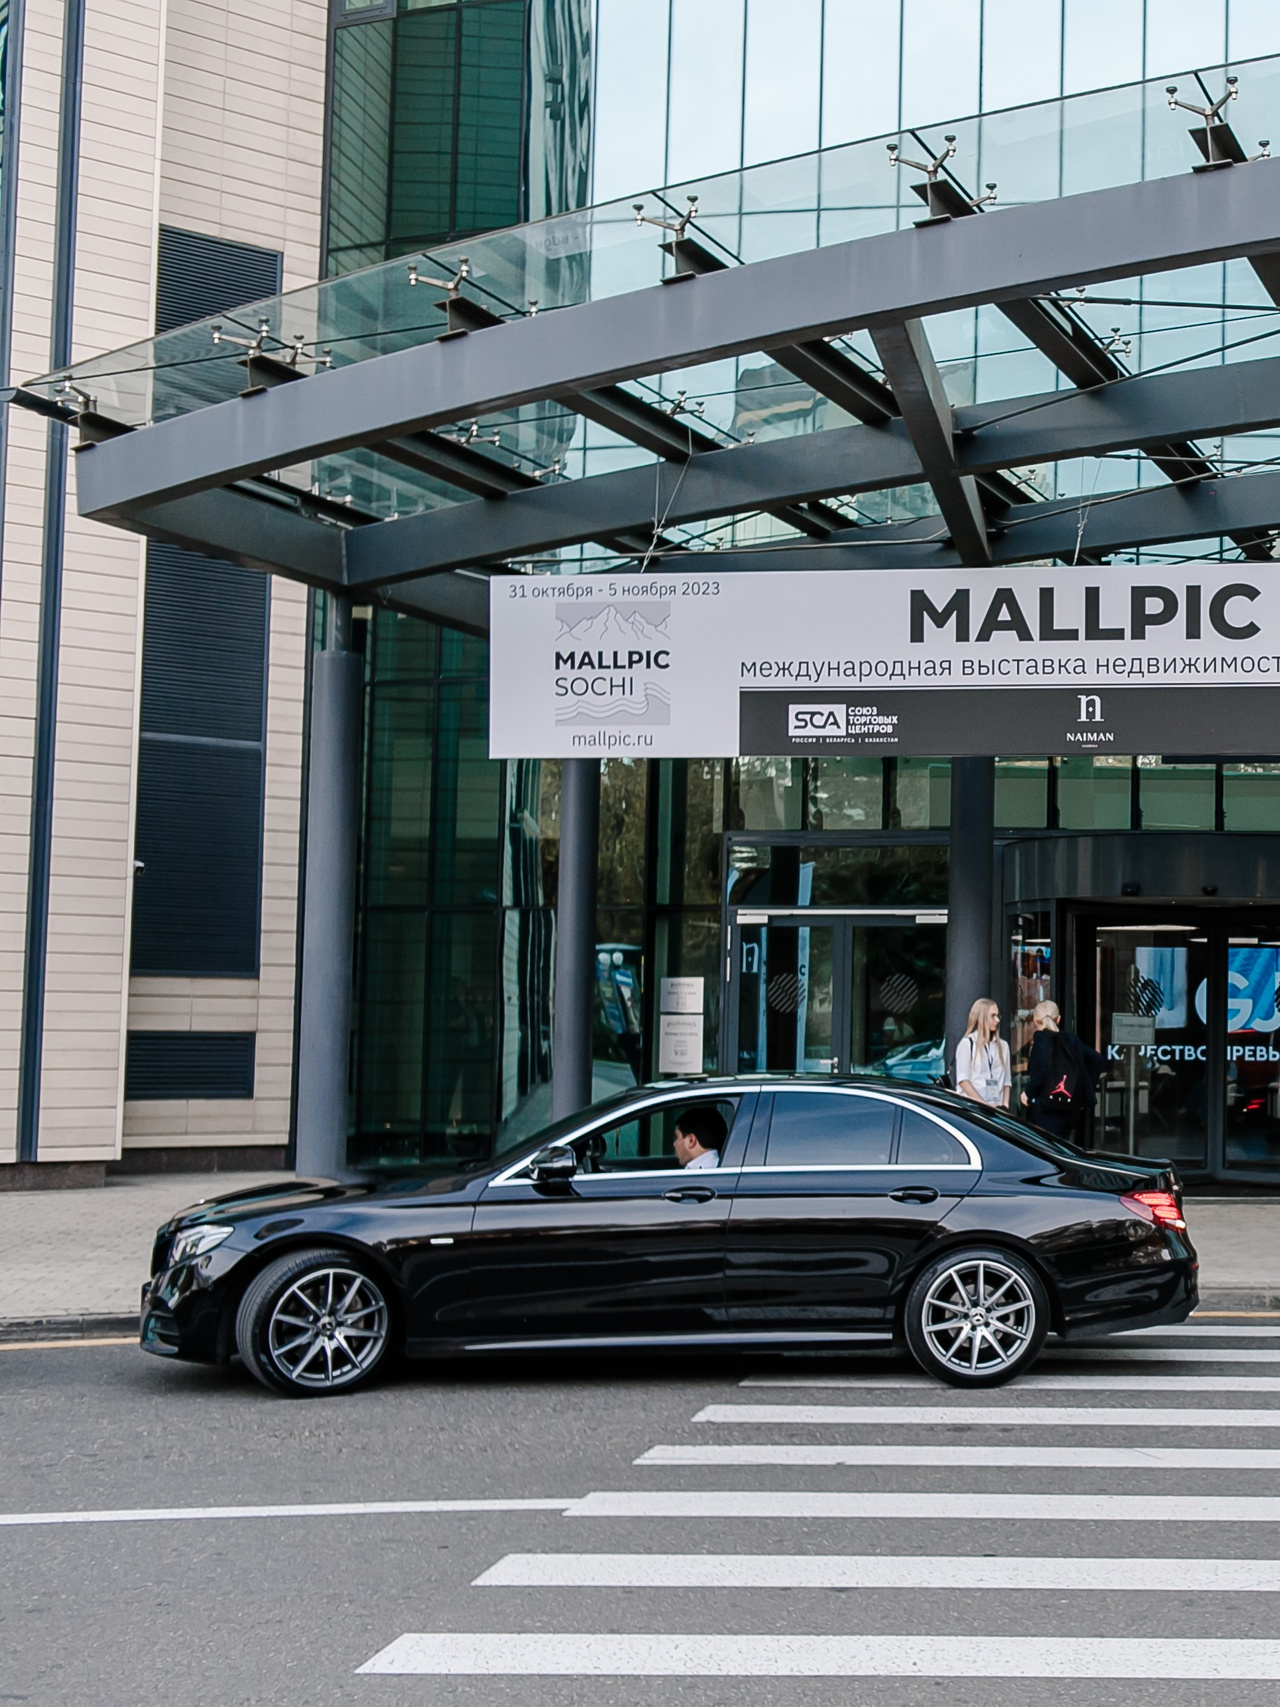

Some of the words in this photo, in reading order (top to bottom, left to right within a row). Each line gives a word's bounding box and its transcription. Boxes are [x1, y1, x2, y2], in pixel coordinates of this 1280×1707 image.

[509, 584, 527, 599] 31
[532, 582, 593, 600] октября
[608, 582, 617, 597] 5
[623, 581, 677, 600] ноября
[681, 581, 720, 597] 2023
[909, 582, 1262, 644] MALLPIC
[554, 649, 671, 671] MALLPIC
[740, 659, 952, 683] международная
[962, 657, 1087, 676] выставка
[554, 676, 634, 697] SOCHI
[794, 711, 842, 730] SCA
[848, 706, 878, 716] СОЮЗ
[848, 715, 899, 725] ТОРГОВЫХ
[848, 724, 894, 735] ЦЕНТРОВ
[1066, 732, 1115, 742] NAIMAN
[572, 730, 653, 750] mallpic.ru
